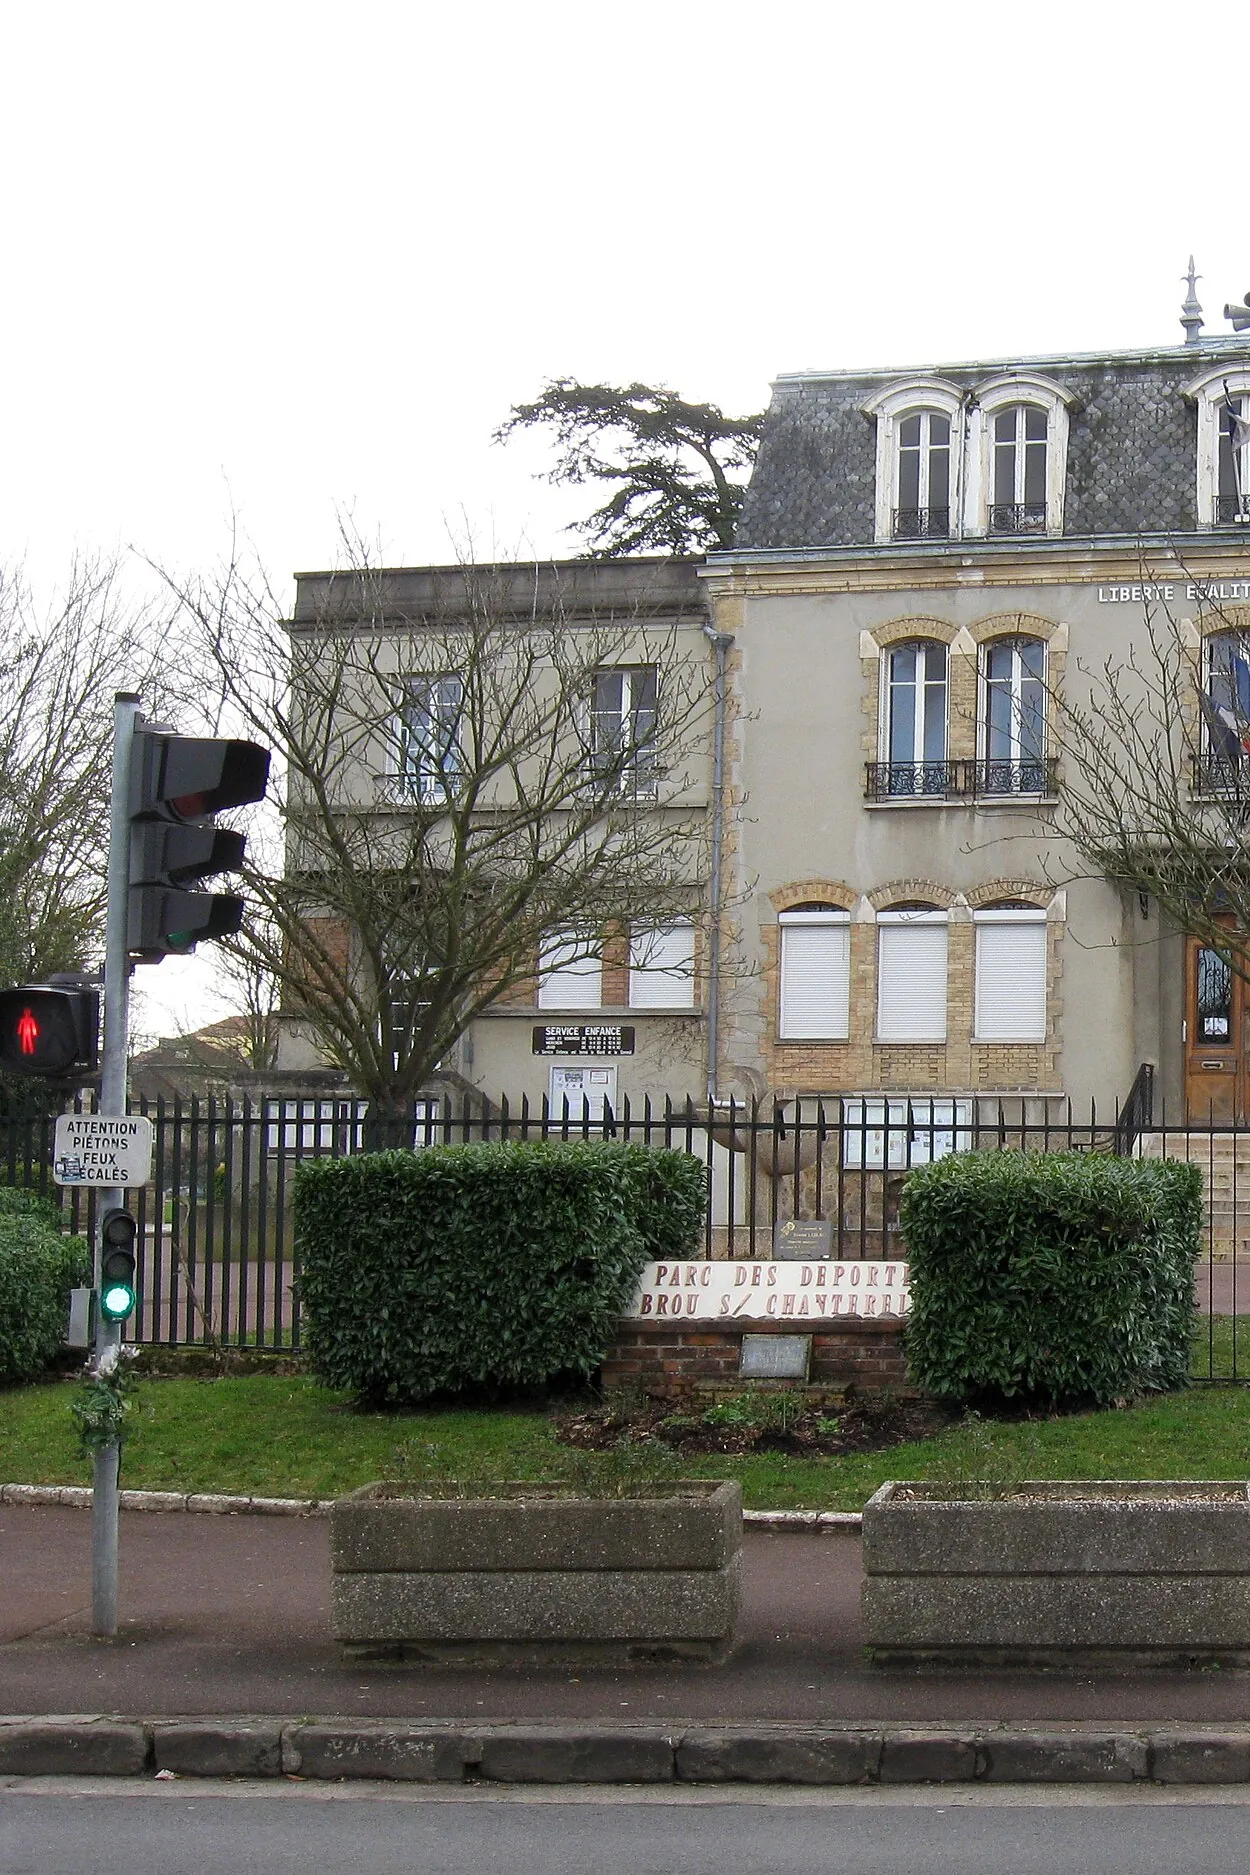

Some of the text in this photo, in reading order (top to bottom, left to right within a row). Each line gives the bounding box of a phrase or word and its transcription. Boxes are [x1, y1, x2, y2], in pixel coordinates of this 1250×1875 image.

[1098, 585, 1174, 602] LIBERTE
[545, 1027, 622, 1036] SERVICE ENFANCE
[67, 1121, 137, 1135] ATTENTION
[73, 1134, 129, 1150] PIÉTONS
[83, 1152, 116, 1165] FEUX
[79, 1165, 129, 1181] ÉCALÉS
[655, 1265, 911, 1287] PARC DES DEPORTE
[639, 1293, 700, 1315] BROU
[766, 1293, 907, 1315] CHANTEREI
